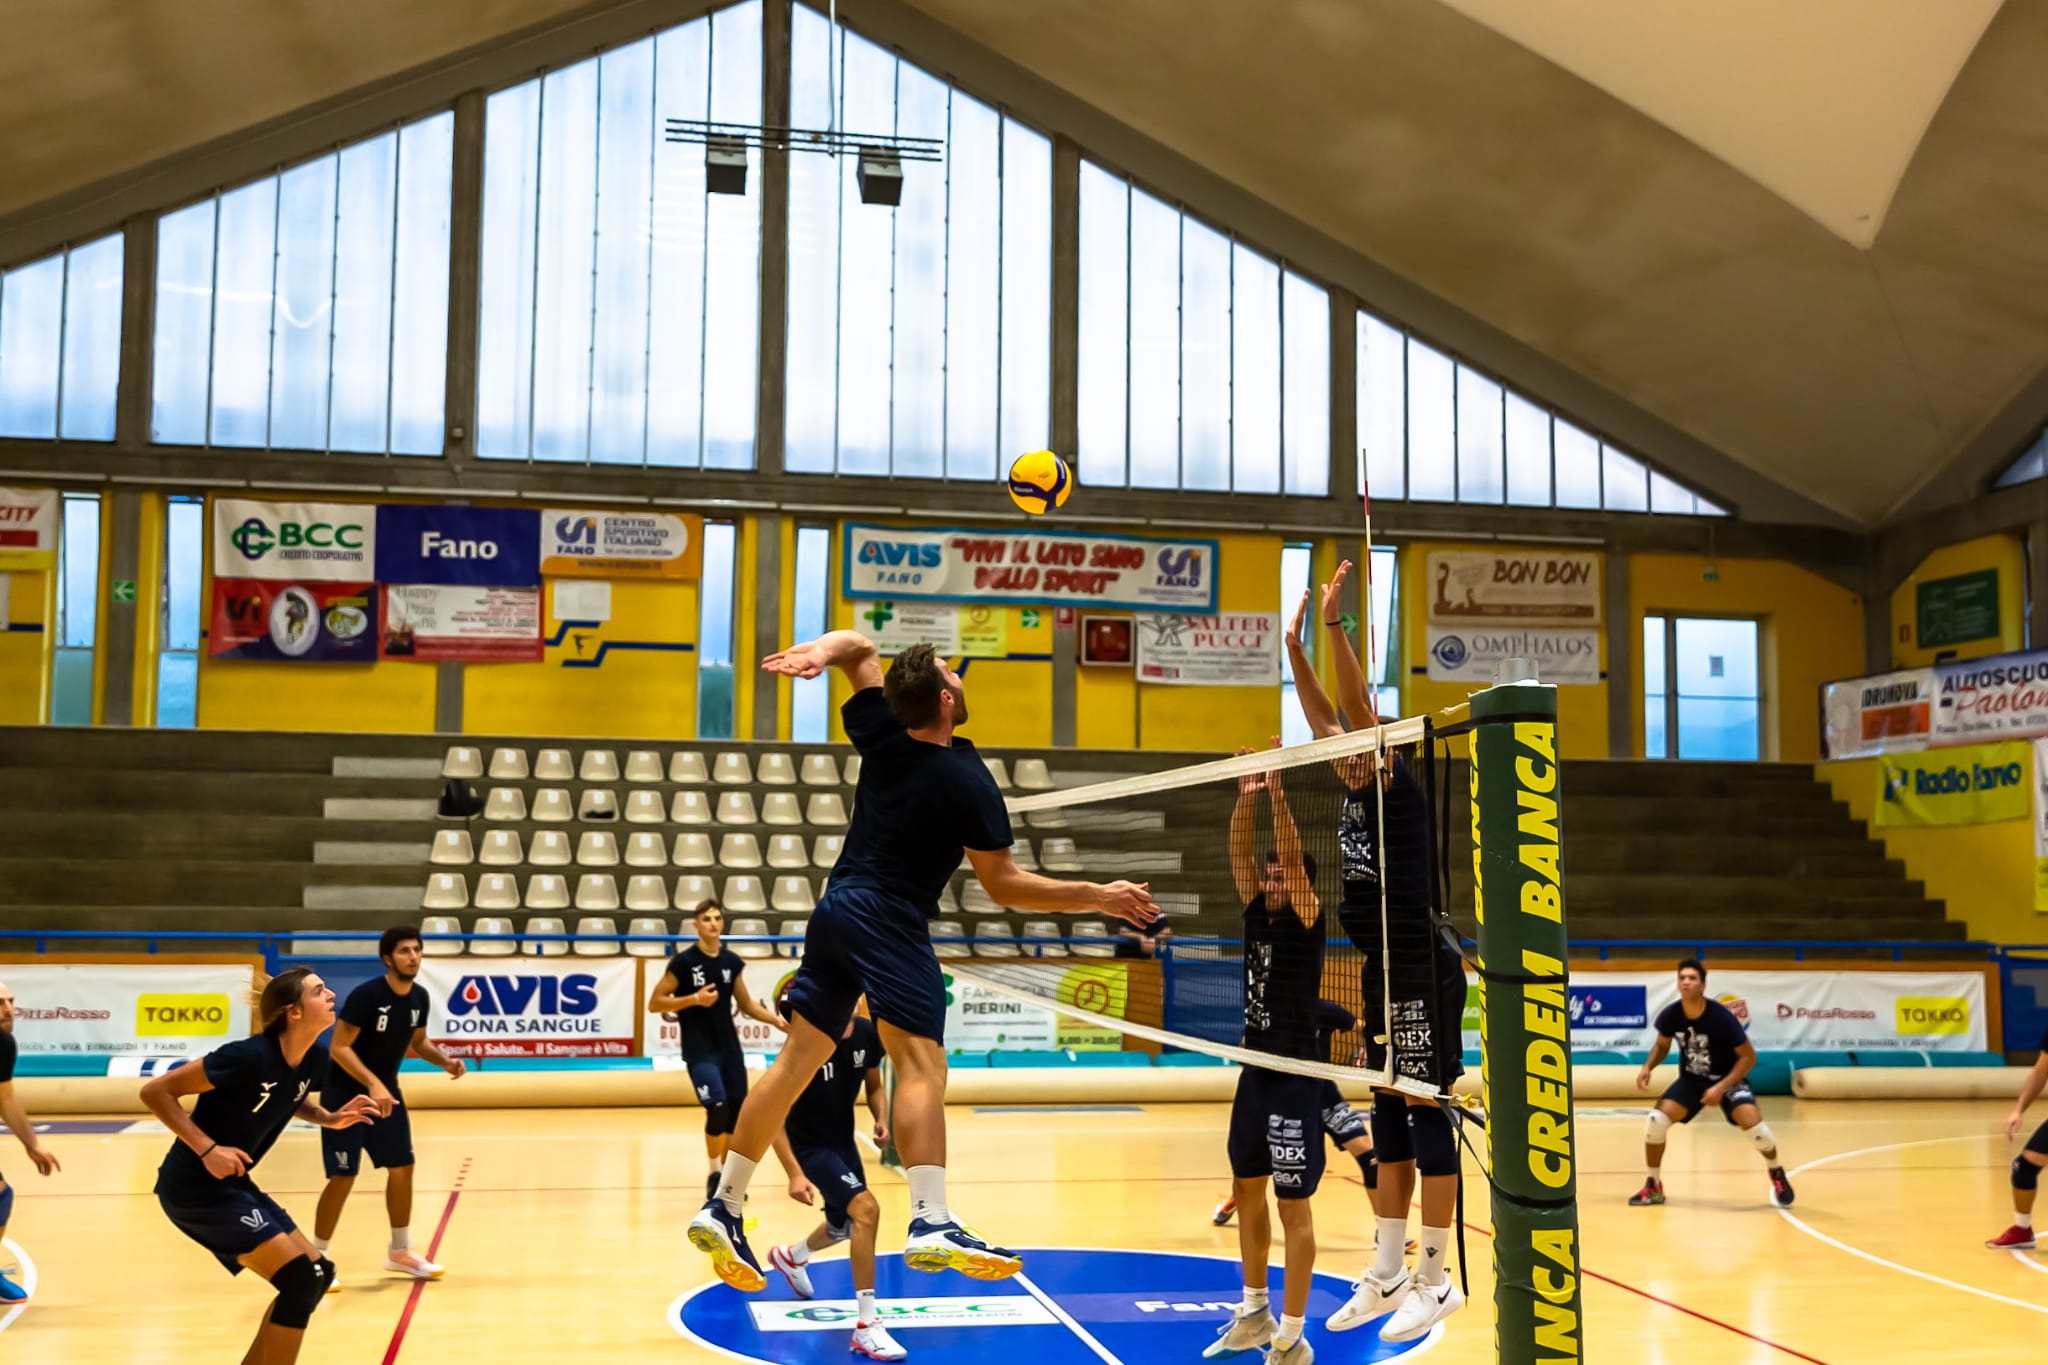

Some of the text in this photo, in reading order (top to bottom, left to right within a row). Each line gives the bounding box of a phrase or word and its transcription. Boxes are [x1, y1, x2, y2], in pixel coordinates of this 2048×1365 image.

[604, 517, 656, 528] CENTRO
[280, 522, 363, 550] BCC
[604, 527, 669, 538] SPORTIVO
[420, 530, 499, 560] Fano
[557, 545, 595, 555] FANO
[604, 537, 662, 547] ITALIANO
[858, 540, 942, 568] AVIS
[1011, 540, 1031, 564] IL
[1036, 541, 1087, 567] LATO
[1089, 544, 1146, 570] SANO
[876, 571, 922, 585] FANO
[974, 565, 1040, 590] DELLO
[1492, 559, 1592, 585] BON BON
[1157, 575, 1200, 588] FANO
[1185, 615, 1270, 632] VALTER
[1193, 632, 1264, 648] PUCCI
[1471, 632, 1594, 655] OMPHALOS
[1915, 766, 1970, 796] Radio
[1513, 722, 1565, 925] BANCA
[692, 971, 706, 987] 15
[447, 973, 599, 1016] AVIS
[962, 1002, 1022, 1015] PIERINI
[376, 1014, 389, 1032] 8
[446, 1018, 602, 1034] DONA SANGUE
[437, 1042, 472, 1057] Sport
[546, 1042, 592, 1058] Sangue
[603, 1041, 629, 1054] Vita
[822, 1061, 834, 1082] 11
[1521, 948, 1572, 1190] CREDEM
[252, 1092, 271, 1114] 7
[1531, 1229, 1579, 1365] NCA
[876, 1303, 1017, 1315] BCC
[1134, 1300, 1236, 1313] Fan
